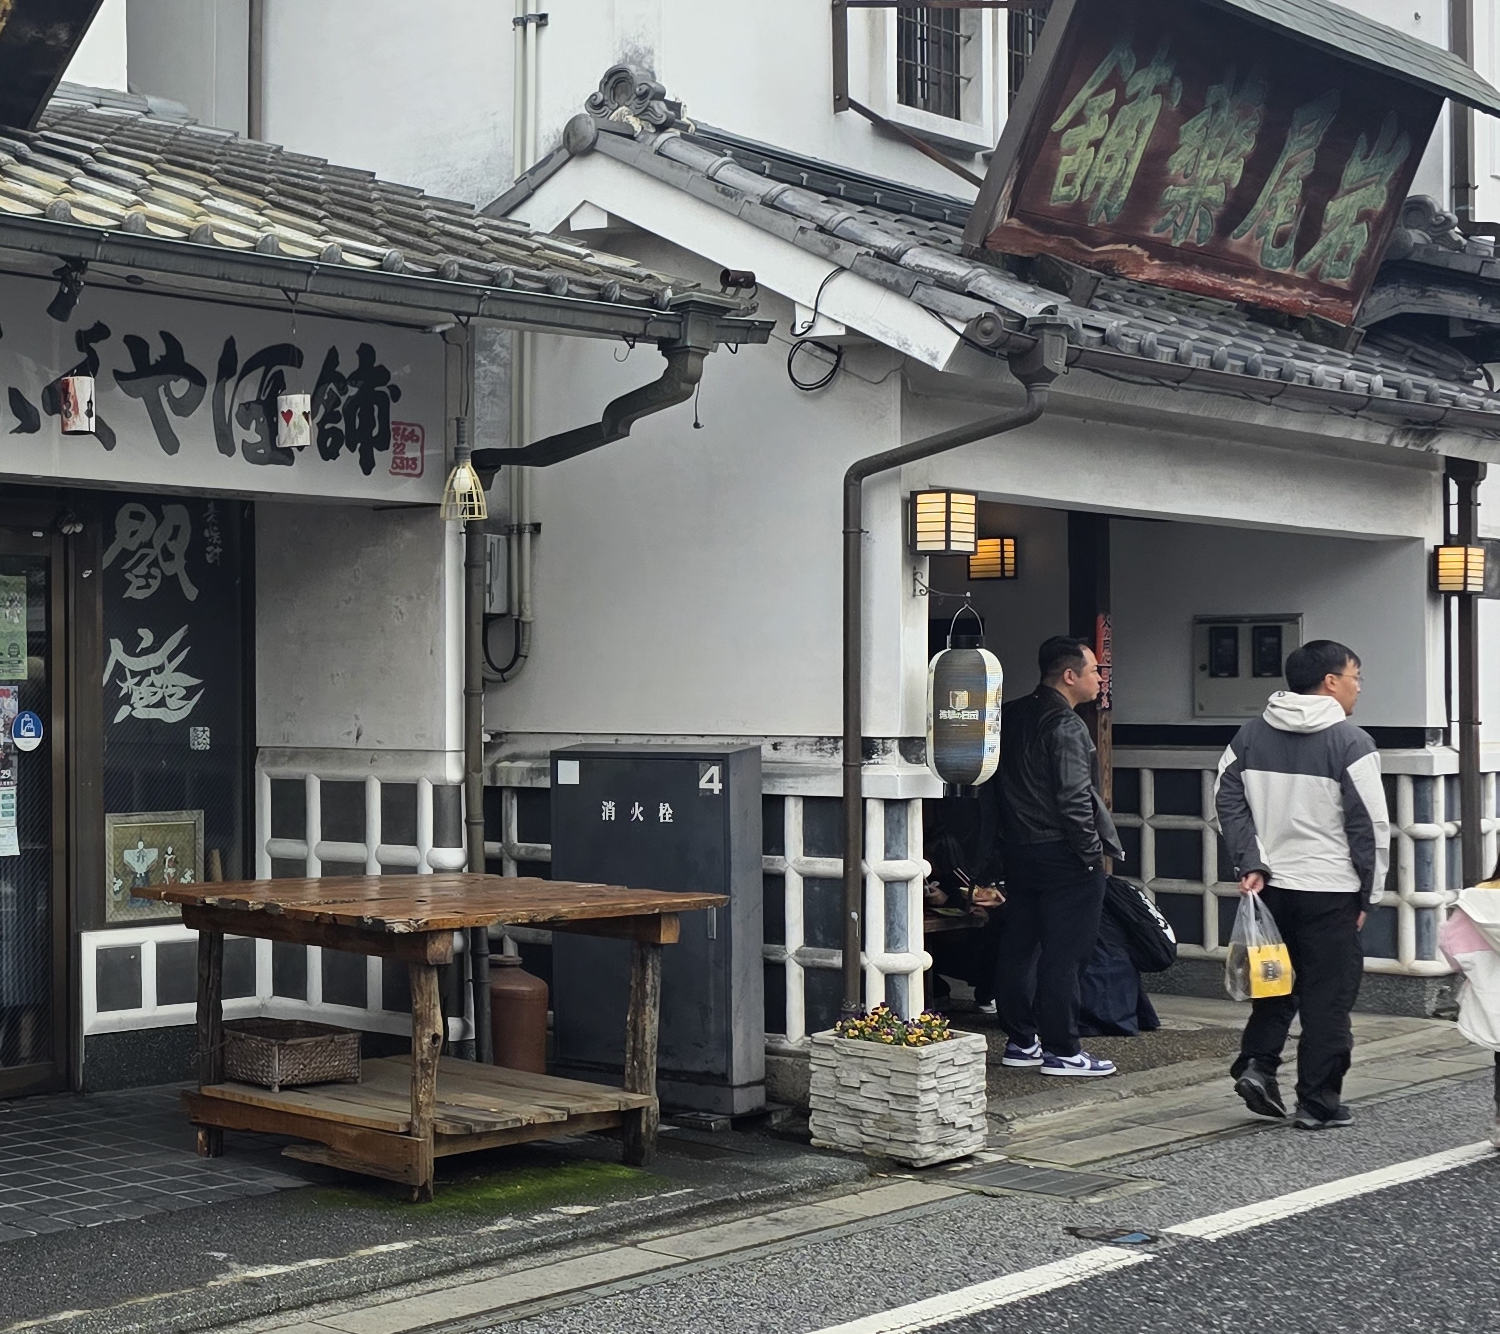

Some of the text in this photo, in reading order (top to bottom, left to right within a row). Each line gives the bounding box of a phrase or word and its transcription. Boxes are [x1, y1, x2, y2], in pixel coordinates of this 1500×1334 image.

[392, 442, 406, 455] 22
[391, 455, 417, 471] 5313
[699, 765, 722, 795] 4
[601, 800, 674, 824] 消火栓
